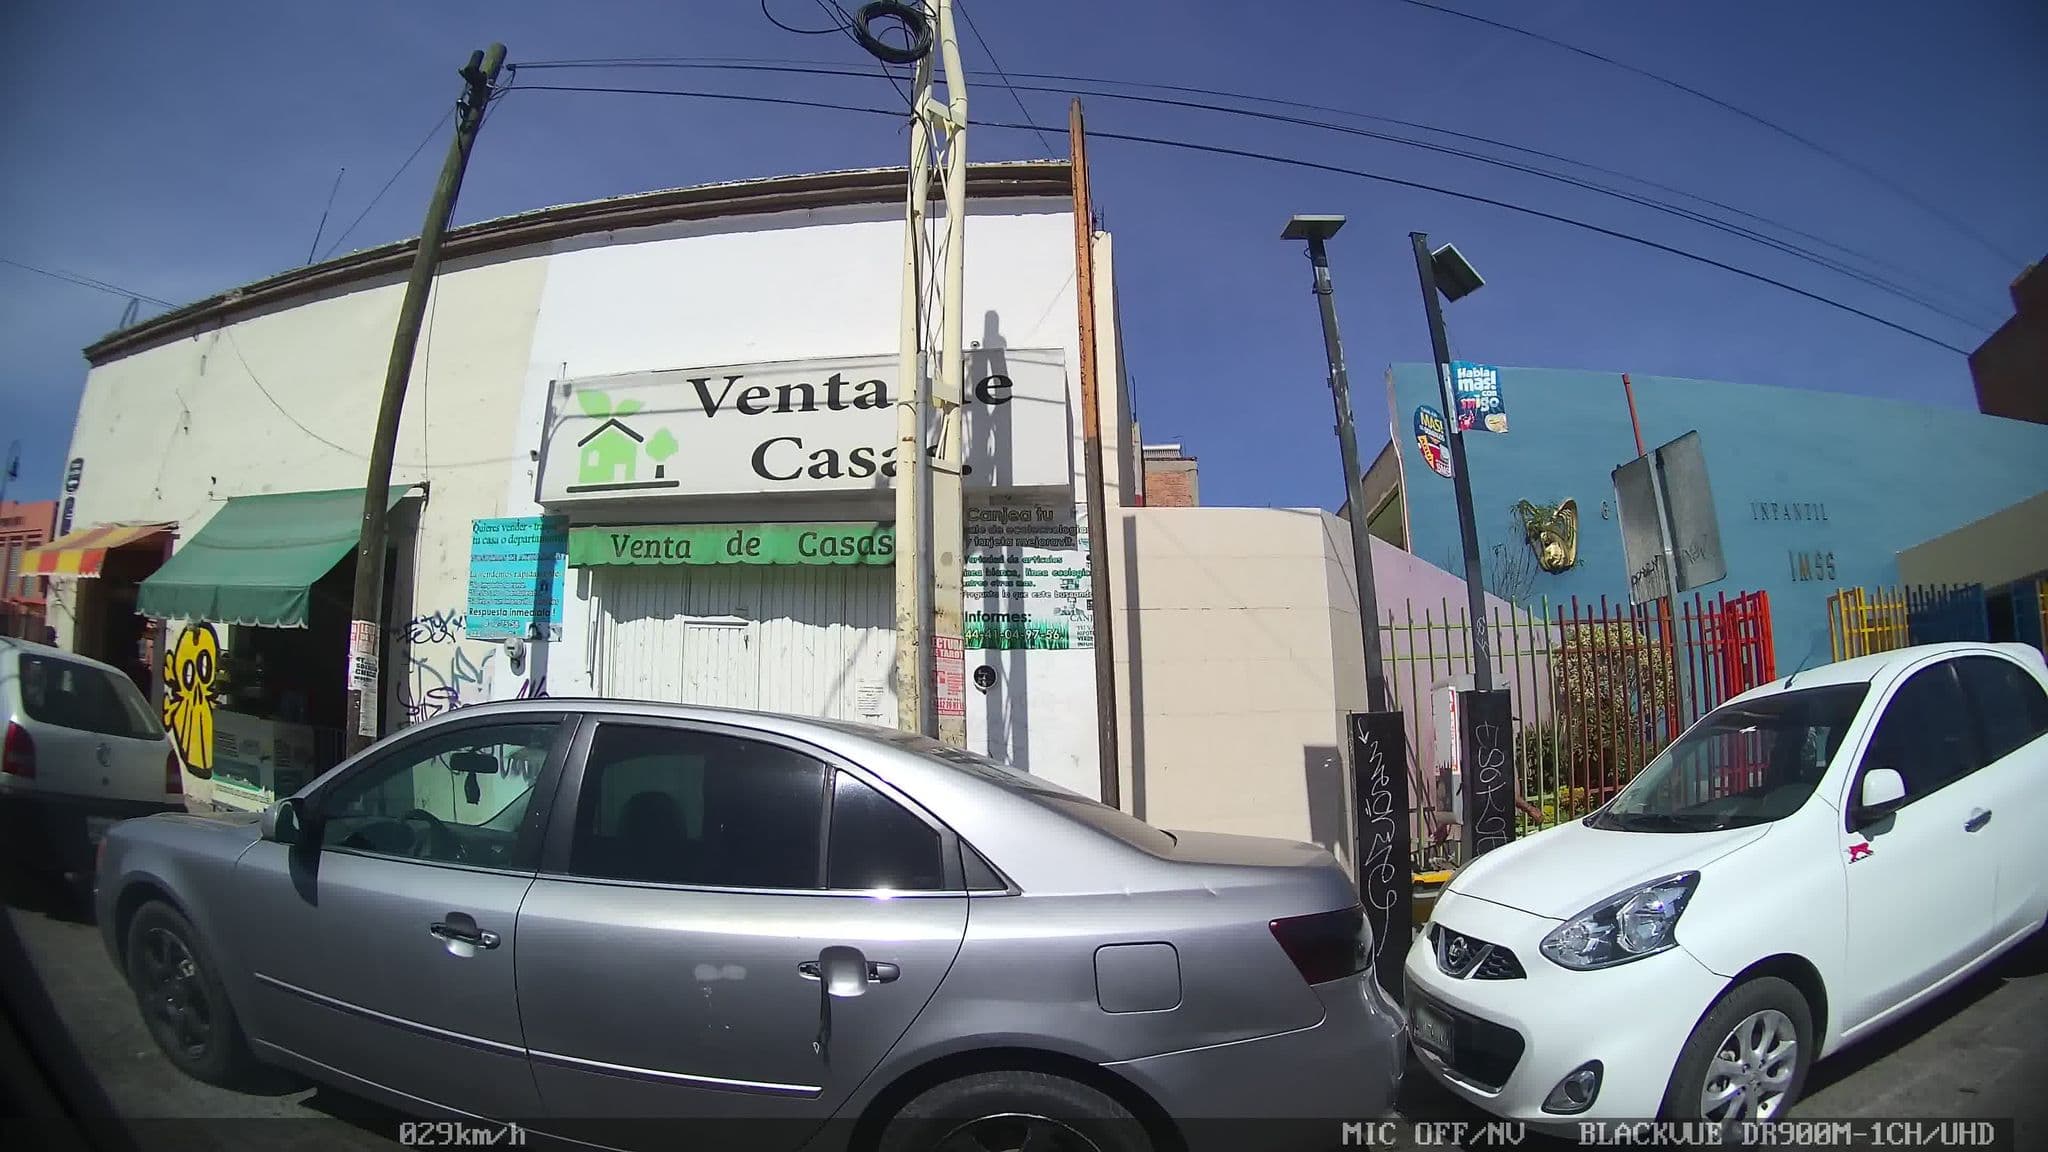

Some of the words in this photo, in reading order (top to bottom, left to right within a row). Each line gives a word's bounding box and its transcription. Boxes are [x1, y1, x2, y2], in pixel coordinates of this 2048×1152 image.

[1457, 367, 1490, 378] Habla
[686, 372, 893, 418] Venta
[962, 372, 1013, 405] e
[751, 436, 973, 481] Cas.
[967, 507, 1031, 525] Canjea
[1036, 506, 1054, 521] tu
[1749, 502, 1829, 521] INFANTIL
[473, 521, 501, 534] Quieres
[502, 519, 528, 532] vender
[472, 536, 481, 545] tu
[482, 536, 500, 545] casa
[610, 534, 692, 558] Venta
[726, 530, 761, 557] de
[798, 532, 893, 557] Casas
[974, 536, 1014, 549] tarjeta
[1787, 550, 1837, 582] IMSS
[469, 607, 508, 617] Respuesta
[964, 610, 1032, 624] Informes:
